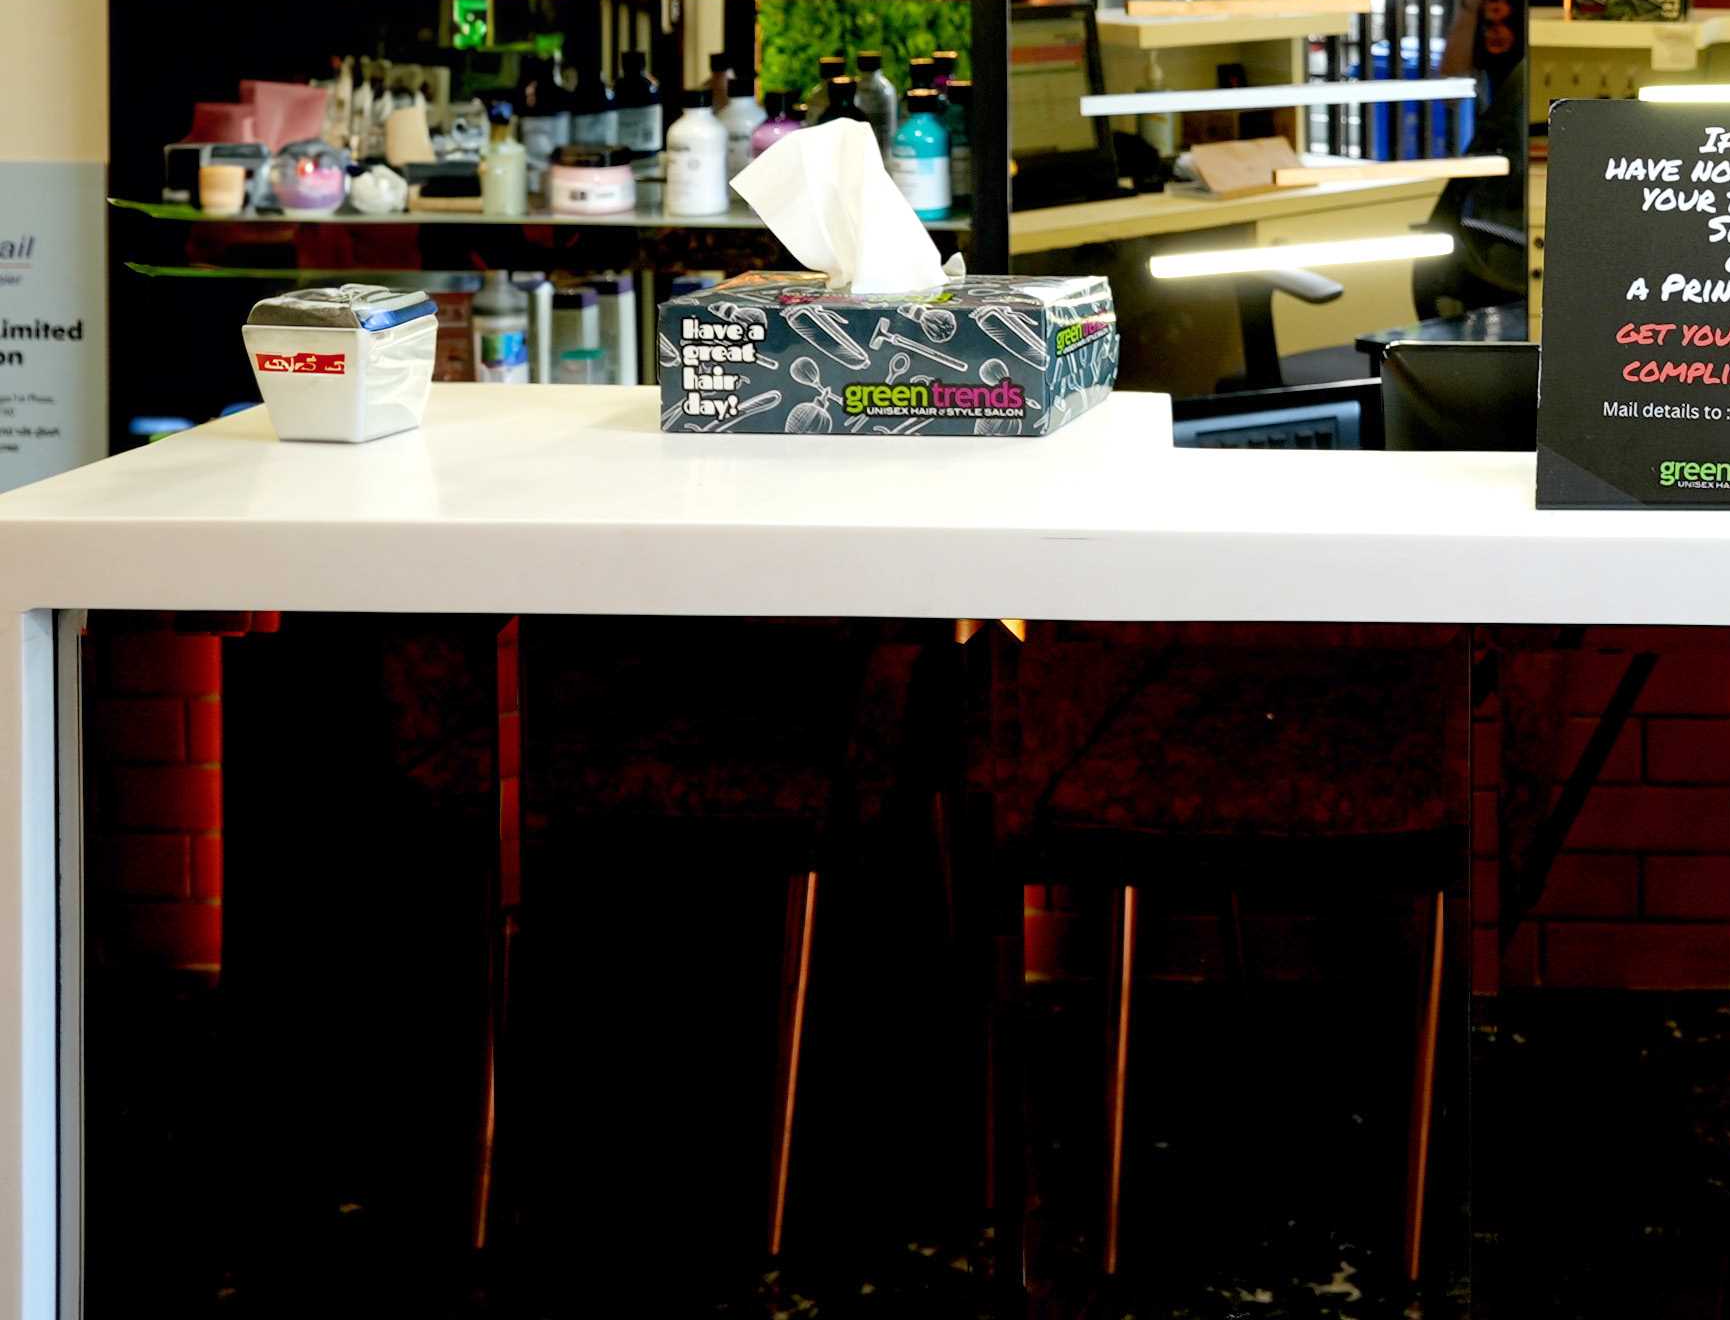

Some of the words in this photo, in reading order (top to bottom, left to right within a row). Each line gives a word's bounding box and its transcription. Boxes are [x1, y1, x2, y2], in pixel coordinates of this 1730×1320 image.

[1604, 157, 1683, 181] HAVE
[1641, 187, 1717, 213] YOUR
[1626, 277, 1650, 302] A
[0, 318, 83, 341] imited
[681, 317, 744, 340] Have
[748, 324, 765, 340] a
[1615, 322, 1676, 346] GET
[682, 342, 756, 366] great
[682, 365, 739, 391] hair
[683, 391, 739, 420] day!
[844, 384, 929, 413] green
[931, 380, 1023, 409] trends
[866, 407, 909, 416] UNISEX
[910, 407, 937, 416] HAIR
[946, 408, 982, 416] STYLE
[985, 408, 1024, 417] SALON
[1603, 401, 1638, 418] Mail
[1642, 402, 1700, 420] details
[1704, 405, 1722, 420] to
[1677, 480, 1715, 489] UNISEX
